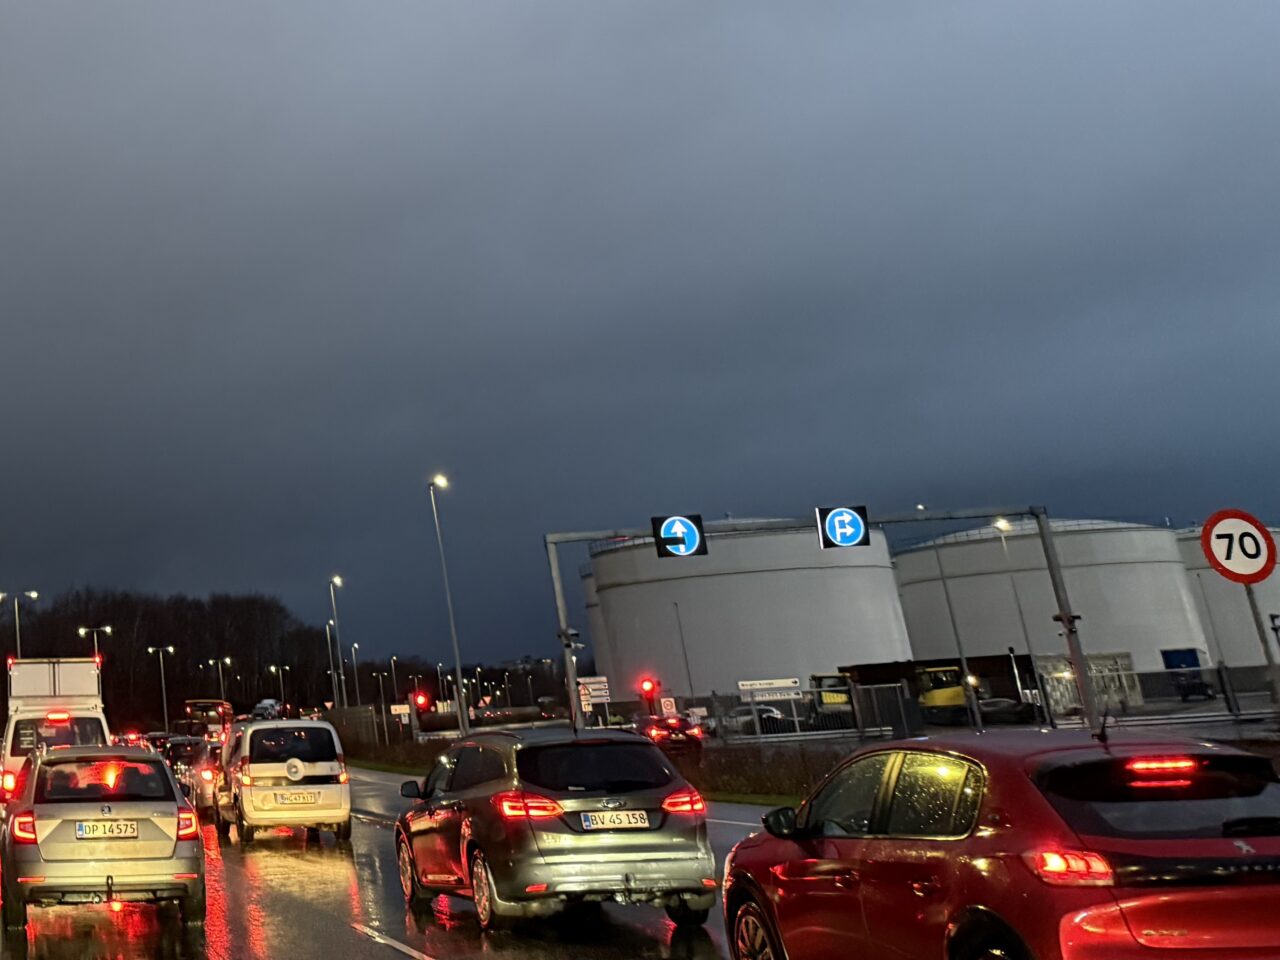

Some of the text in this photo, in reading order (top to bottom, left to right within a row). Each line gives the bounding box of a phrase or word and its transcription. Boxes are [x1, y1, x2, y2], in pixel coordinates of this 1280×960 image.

[1215, 531, 1261, 560] 70
[590, 812, 647, 826] BV 45 158
[84, 824, 99, 835] DP
